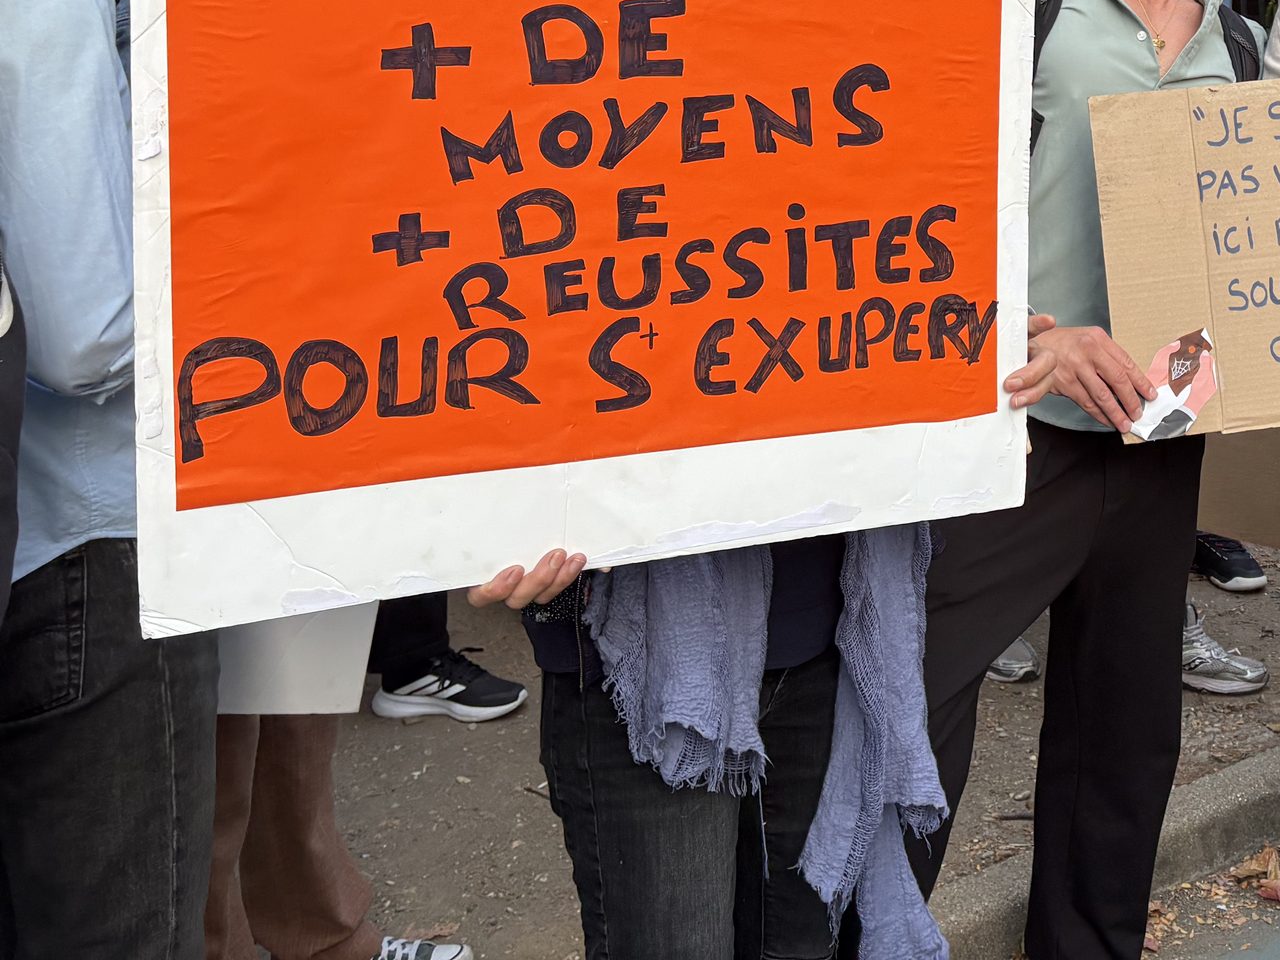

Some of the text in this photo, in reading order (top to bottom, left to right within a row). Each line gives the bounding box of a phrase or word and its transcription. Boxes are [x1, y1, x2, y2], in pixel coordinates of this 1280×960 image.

[440, 63, 890, 185] MOYENS
[497, 183, 668, 259] DE
[1197, 165, 1261, 202] PAS
[177, 326, 540, 464] POUR
[694, 293, 998, 396] EXUPERY
